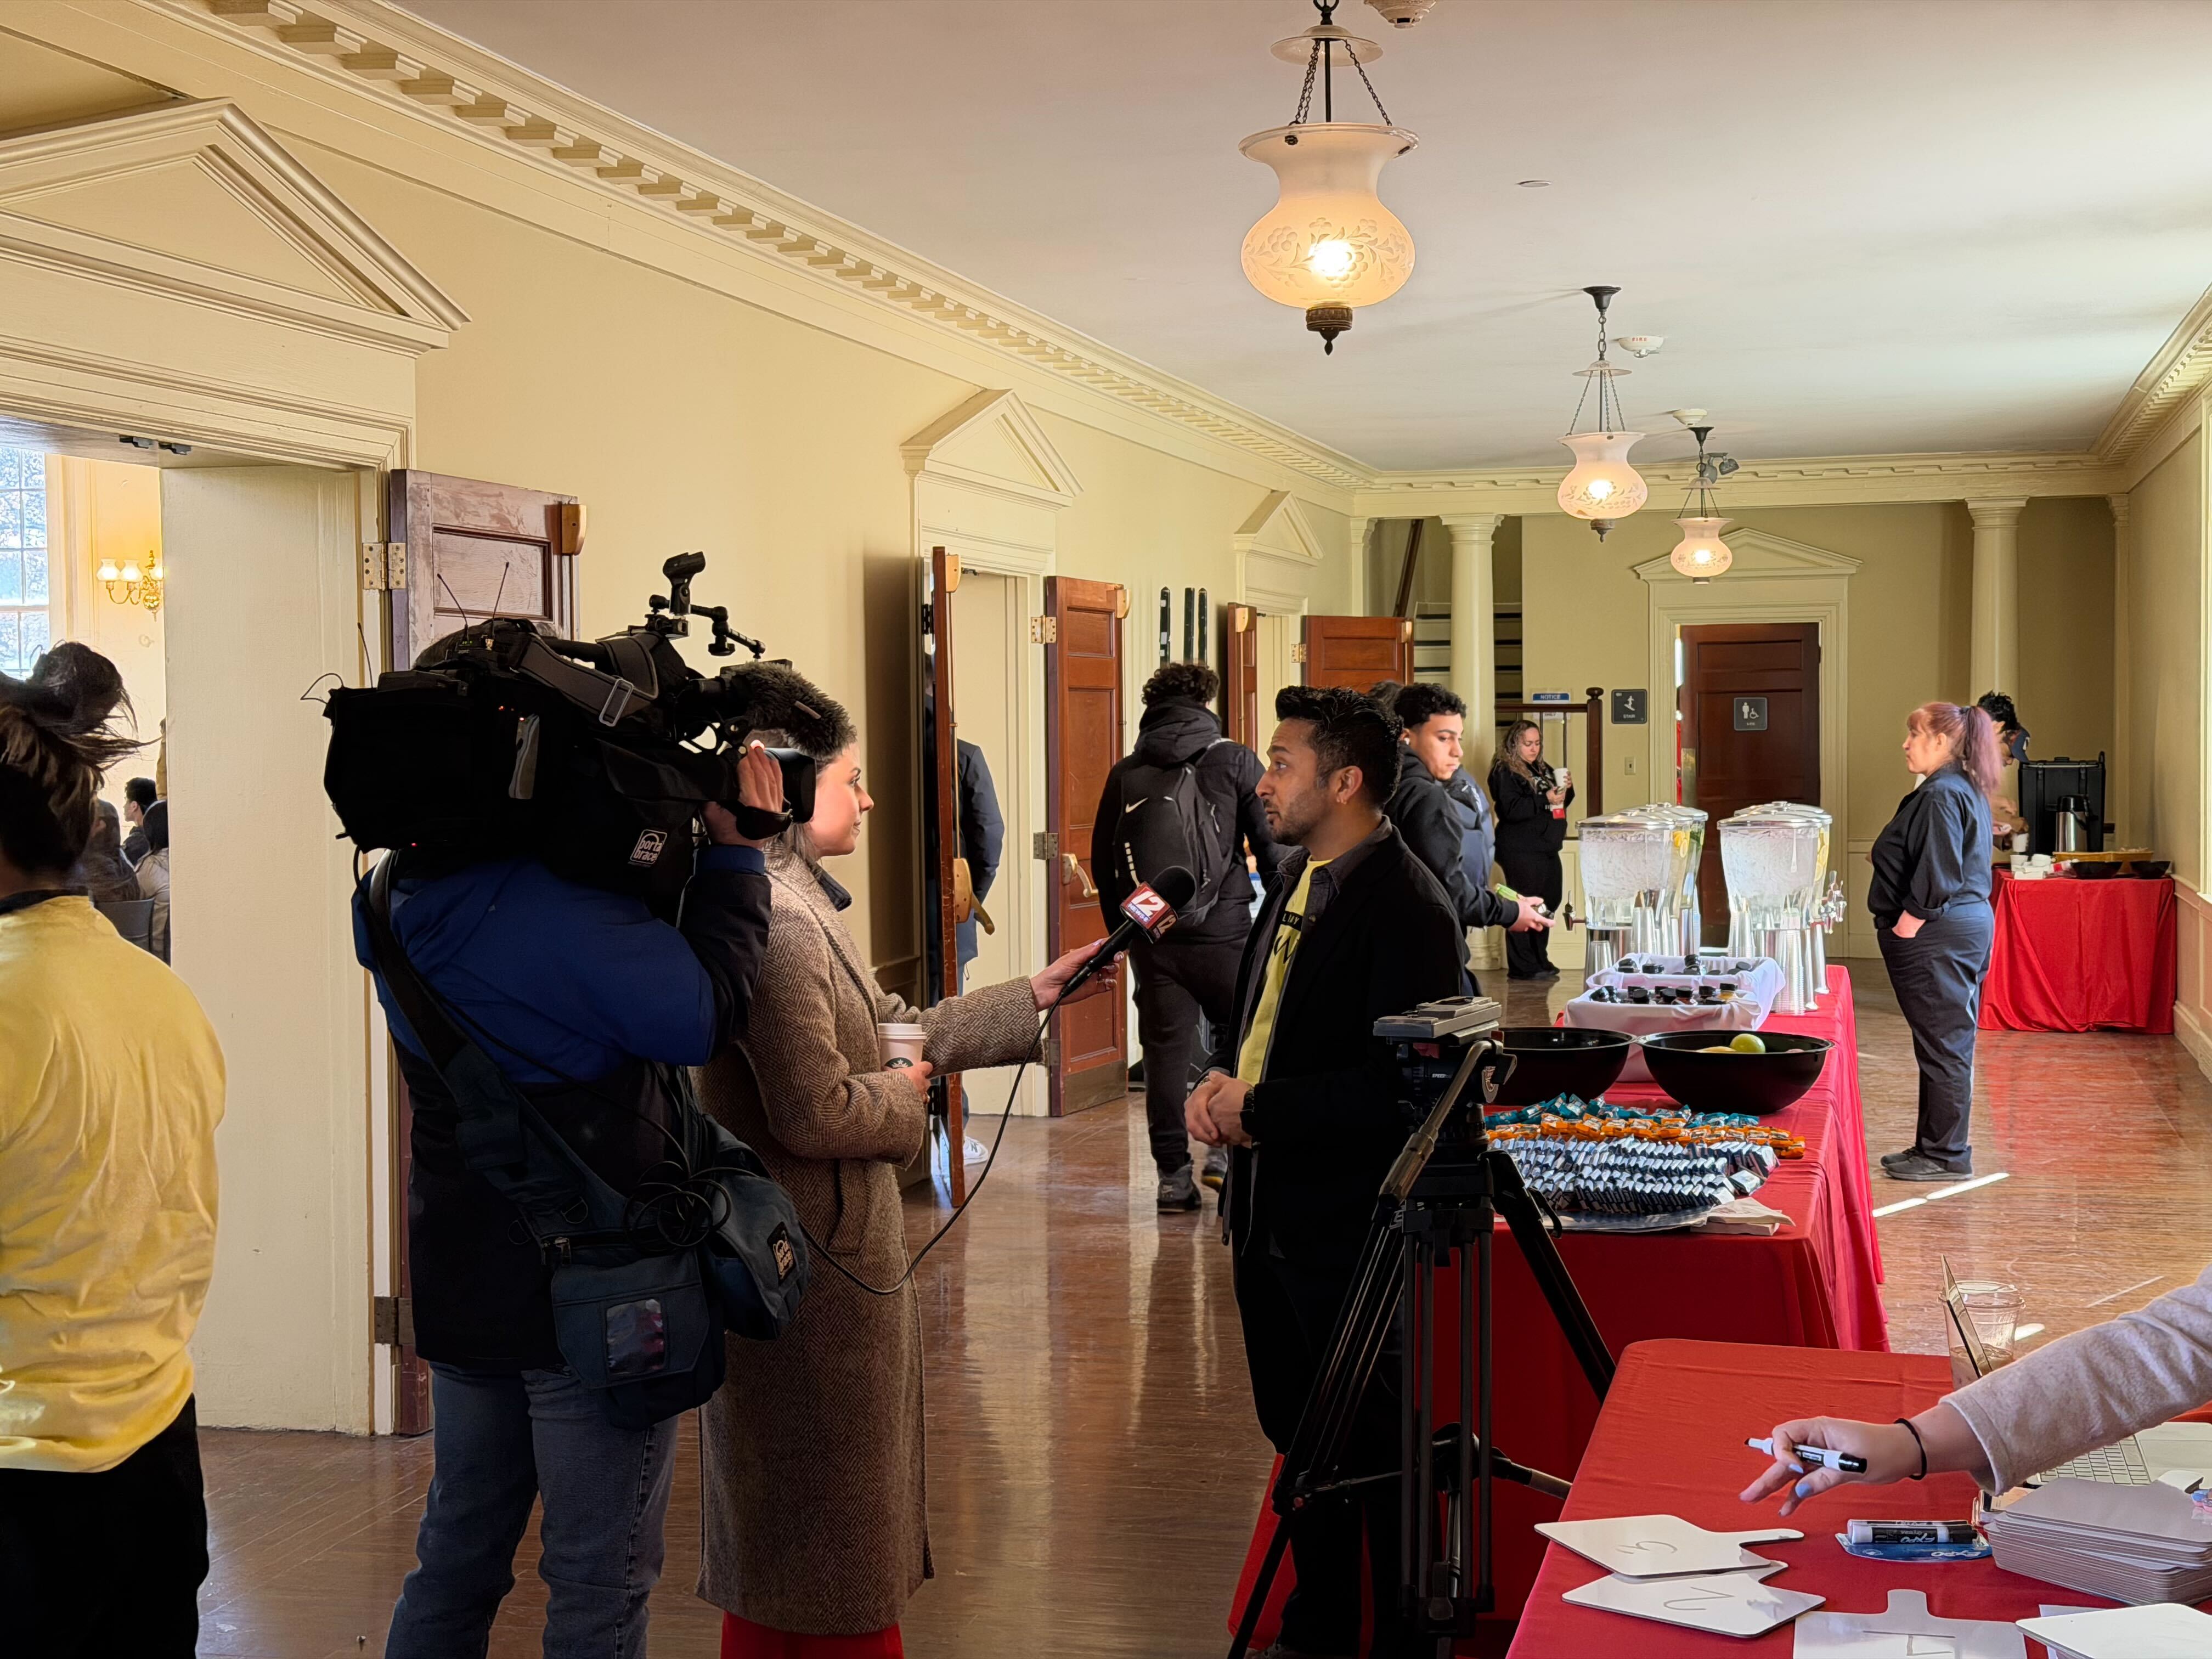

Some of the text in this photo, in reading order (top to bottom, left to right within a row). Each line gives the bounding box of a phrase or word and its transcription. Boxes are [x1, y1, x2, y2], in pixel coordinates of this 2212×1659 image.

[633, 850, 658, 862] brace
[1131, 890, 1166, 917] 12
[1900, 1532, 1936, 1543] EXPO
[1663, 1587, 1736, 1611] 2
